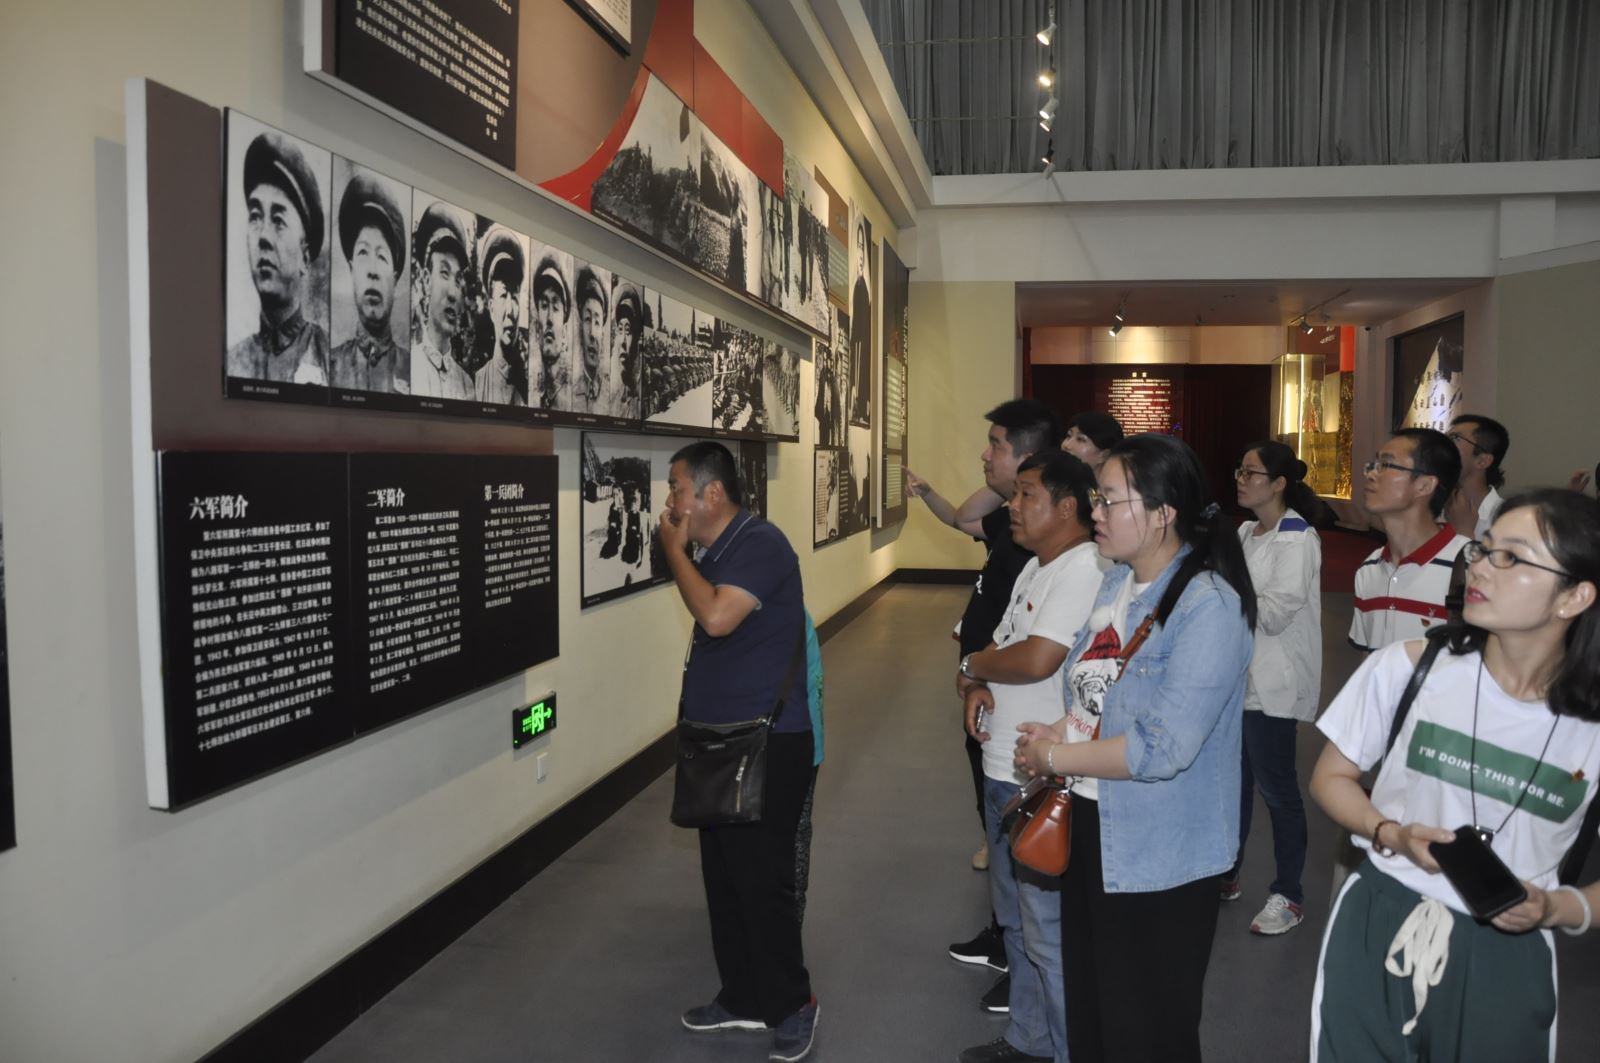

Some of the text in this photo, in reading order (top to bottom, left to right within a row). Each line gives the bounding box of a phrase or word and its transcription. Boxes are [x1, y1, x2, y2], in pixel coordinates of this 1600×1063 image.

[190, 495, 248, 520] 六军简介
[368, 488, 405, 508] 二军简介
[1418, 745, 1565, 808] I'M DOING THIS FOR ME.
